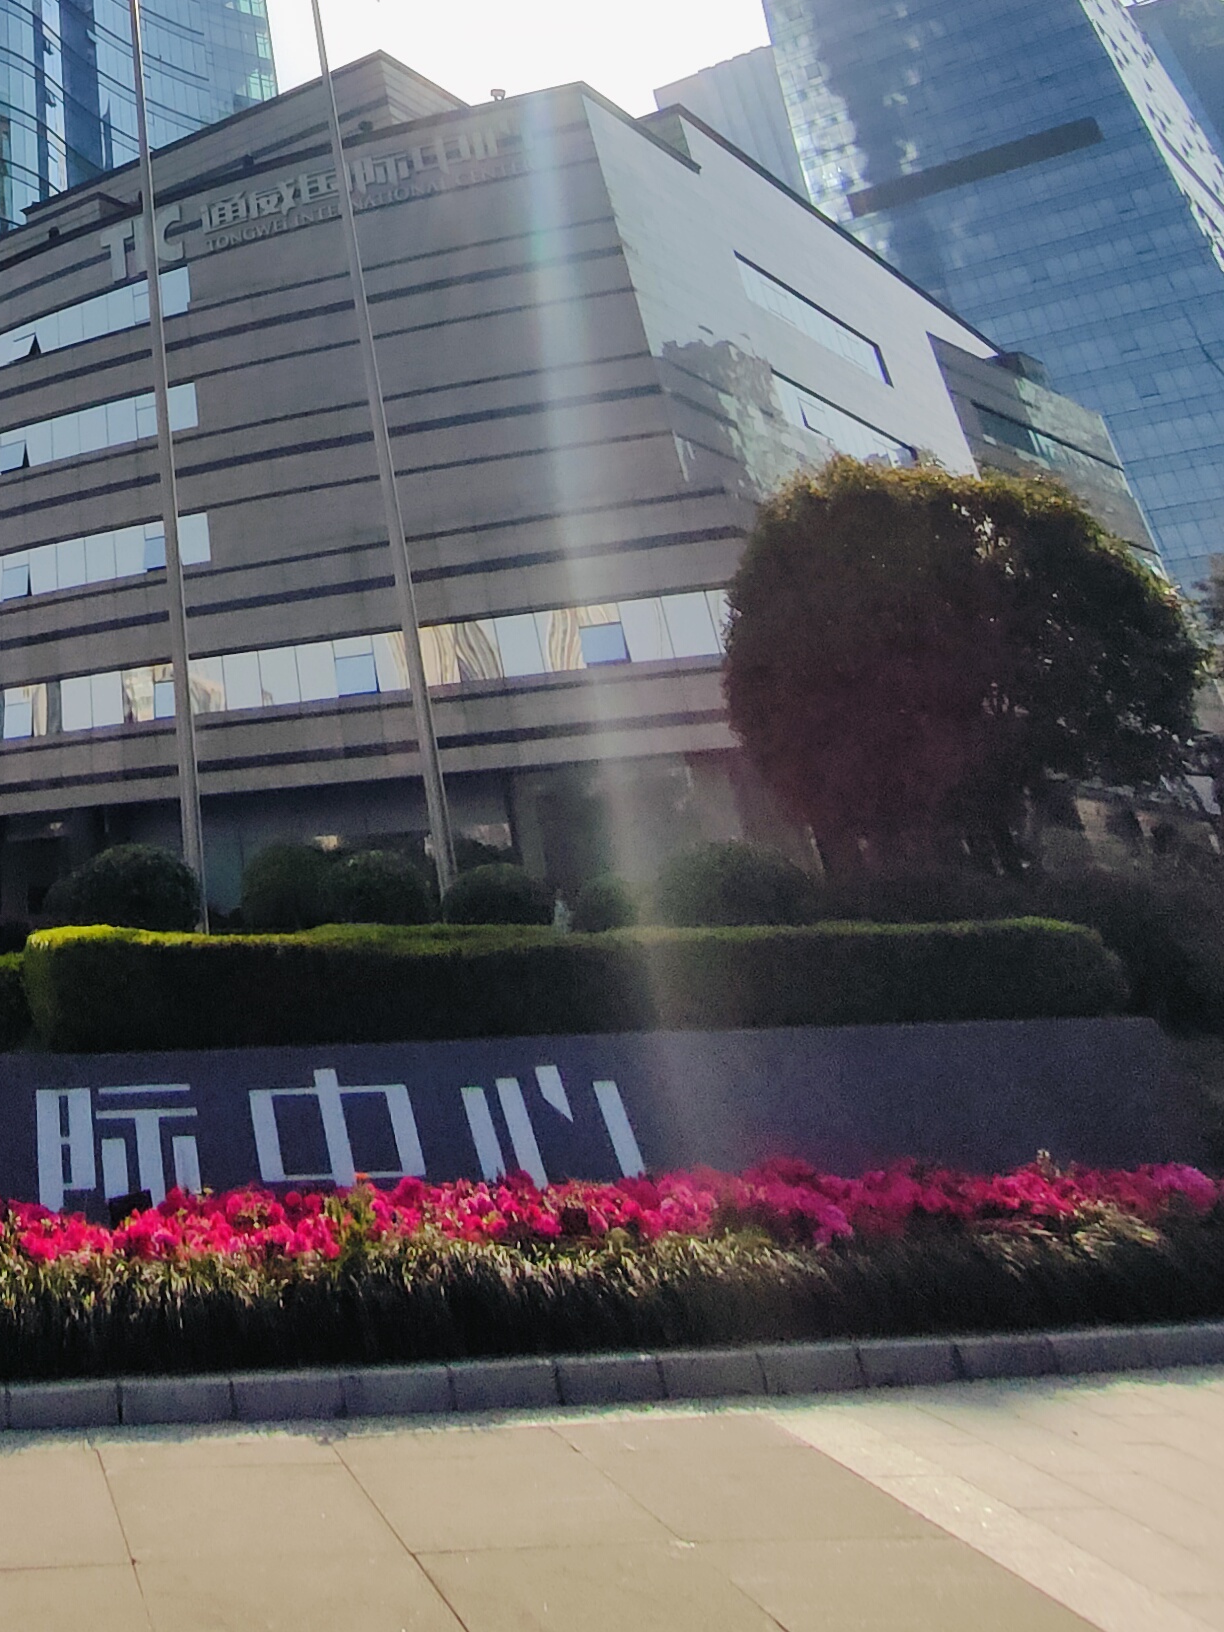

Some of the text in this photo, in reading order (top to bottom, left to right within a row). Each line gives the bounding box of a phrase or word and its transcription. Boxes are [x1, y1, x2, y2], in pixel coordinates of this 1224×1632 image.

[100, 204, 183, 280] TIC
[207, 218, 287, 250] TONGWEI
[294, 178, 446, 226] INTENATIONAL
